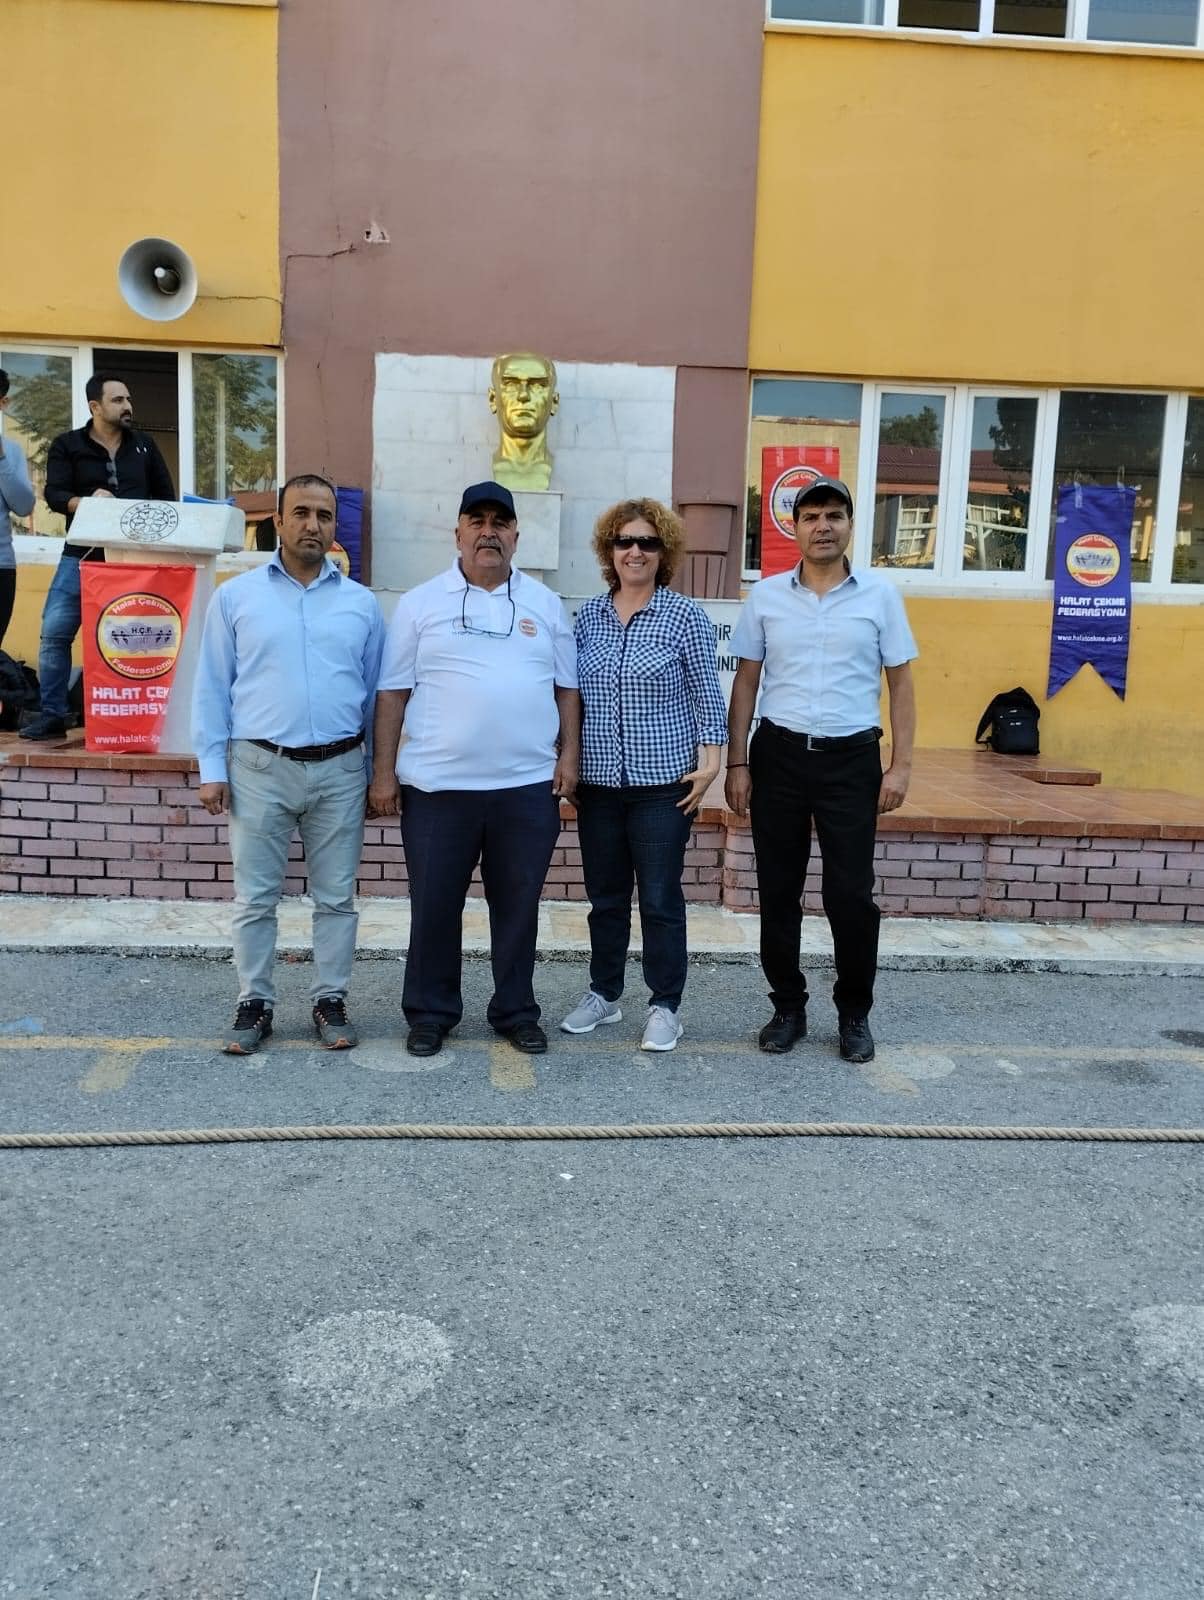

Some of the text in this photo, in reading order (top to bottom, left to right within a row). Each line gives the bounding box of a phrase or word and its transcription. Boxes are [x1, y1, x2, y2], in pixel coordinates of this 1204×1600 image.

[112, 597, 171, 614] Halat Çekme
[1060, 596, 1125, 607] HALAT ÇEKME
[1057, 607, 1126, 617] FEDERASYONU
[112, 657, 173, 675] Federasyonu
[92, 686, 141, 699] HALAT
